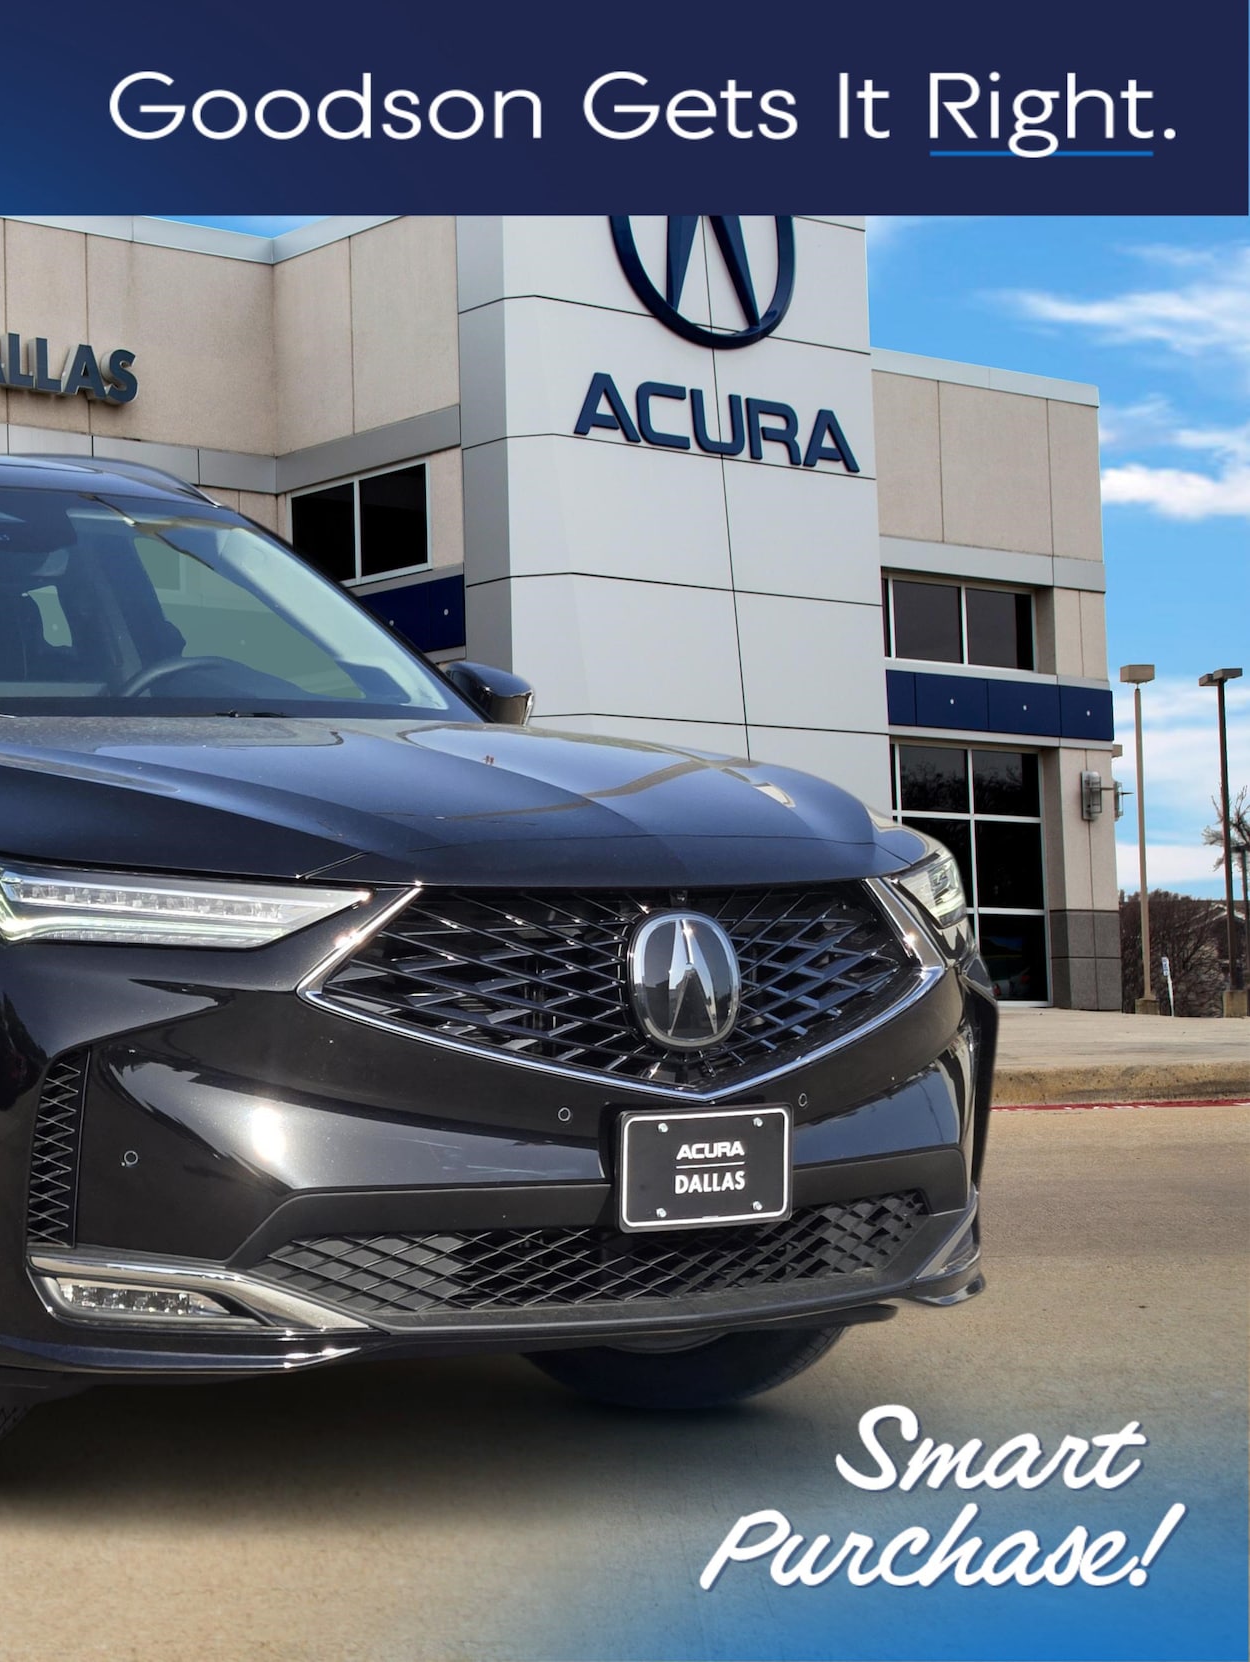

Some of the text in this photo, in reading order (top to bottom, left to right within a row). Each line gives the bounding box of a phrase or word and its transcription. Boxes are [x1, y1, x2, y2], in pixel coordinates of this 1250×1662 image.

[573, 371, 861, 474] ACURA
[676, 1140, 745, 1161] ACURA
[674, 1170, 746, 1195] DALLAS
